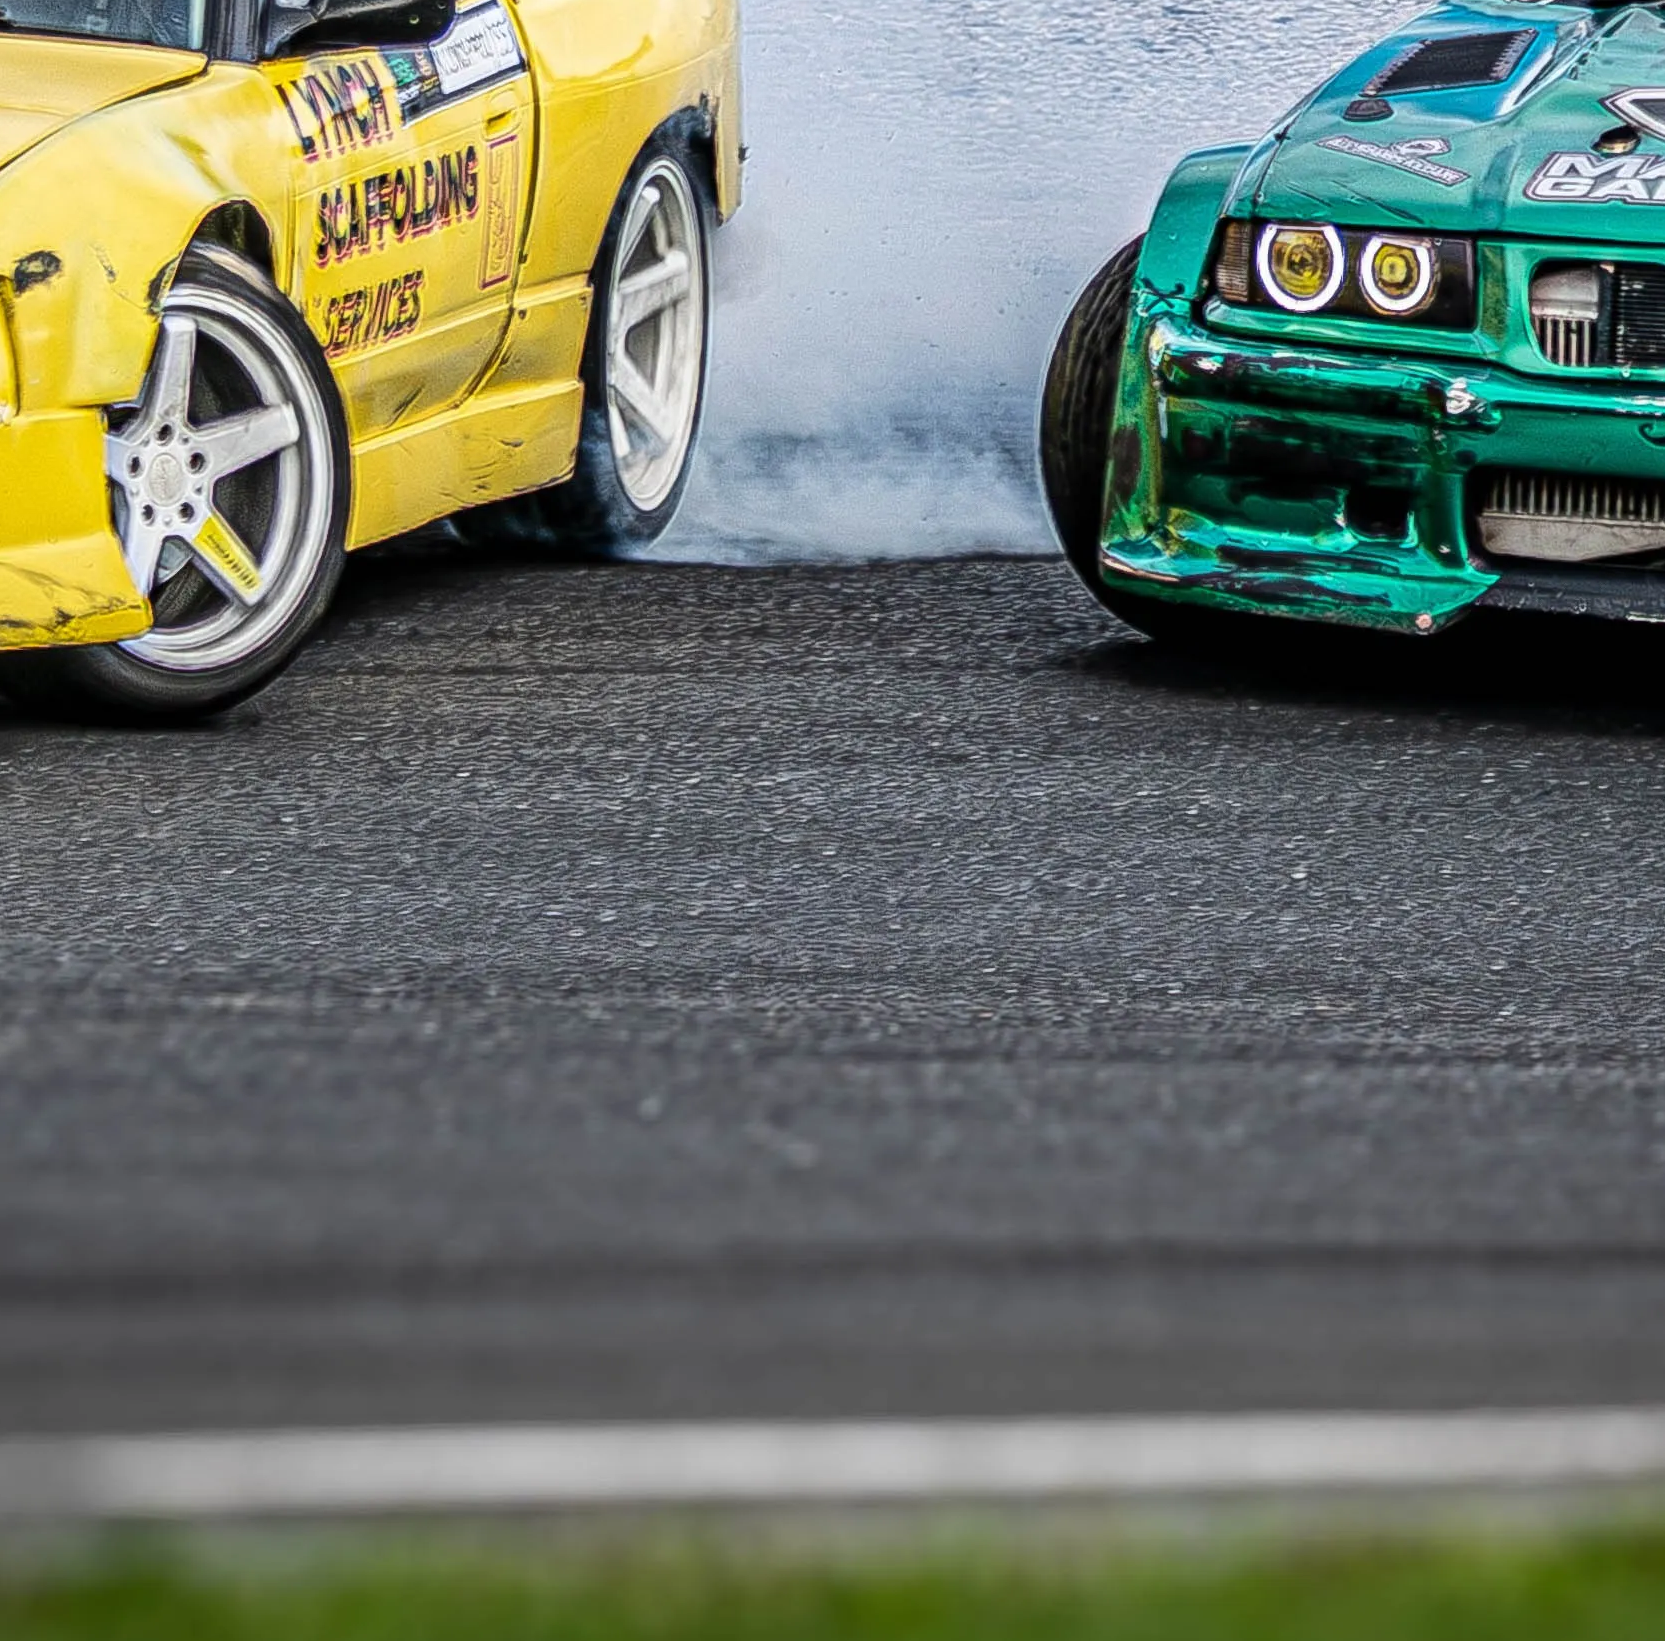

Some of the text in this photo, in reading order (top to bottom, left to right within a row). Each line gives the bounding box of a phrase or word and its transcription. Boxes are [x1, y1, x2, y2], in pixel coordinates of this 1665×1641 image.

[275, 58, 397, 164] LYNCH
[314, 145, 480, 269] SCAFFOLDING
[319, 270, 425, 358] SERVICES
